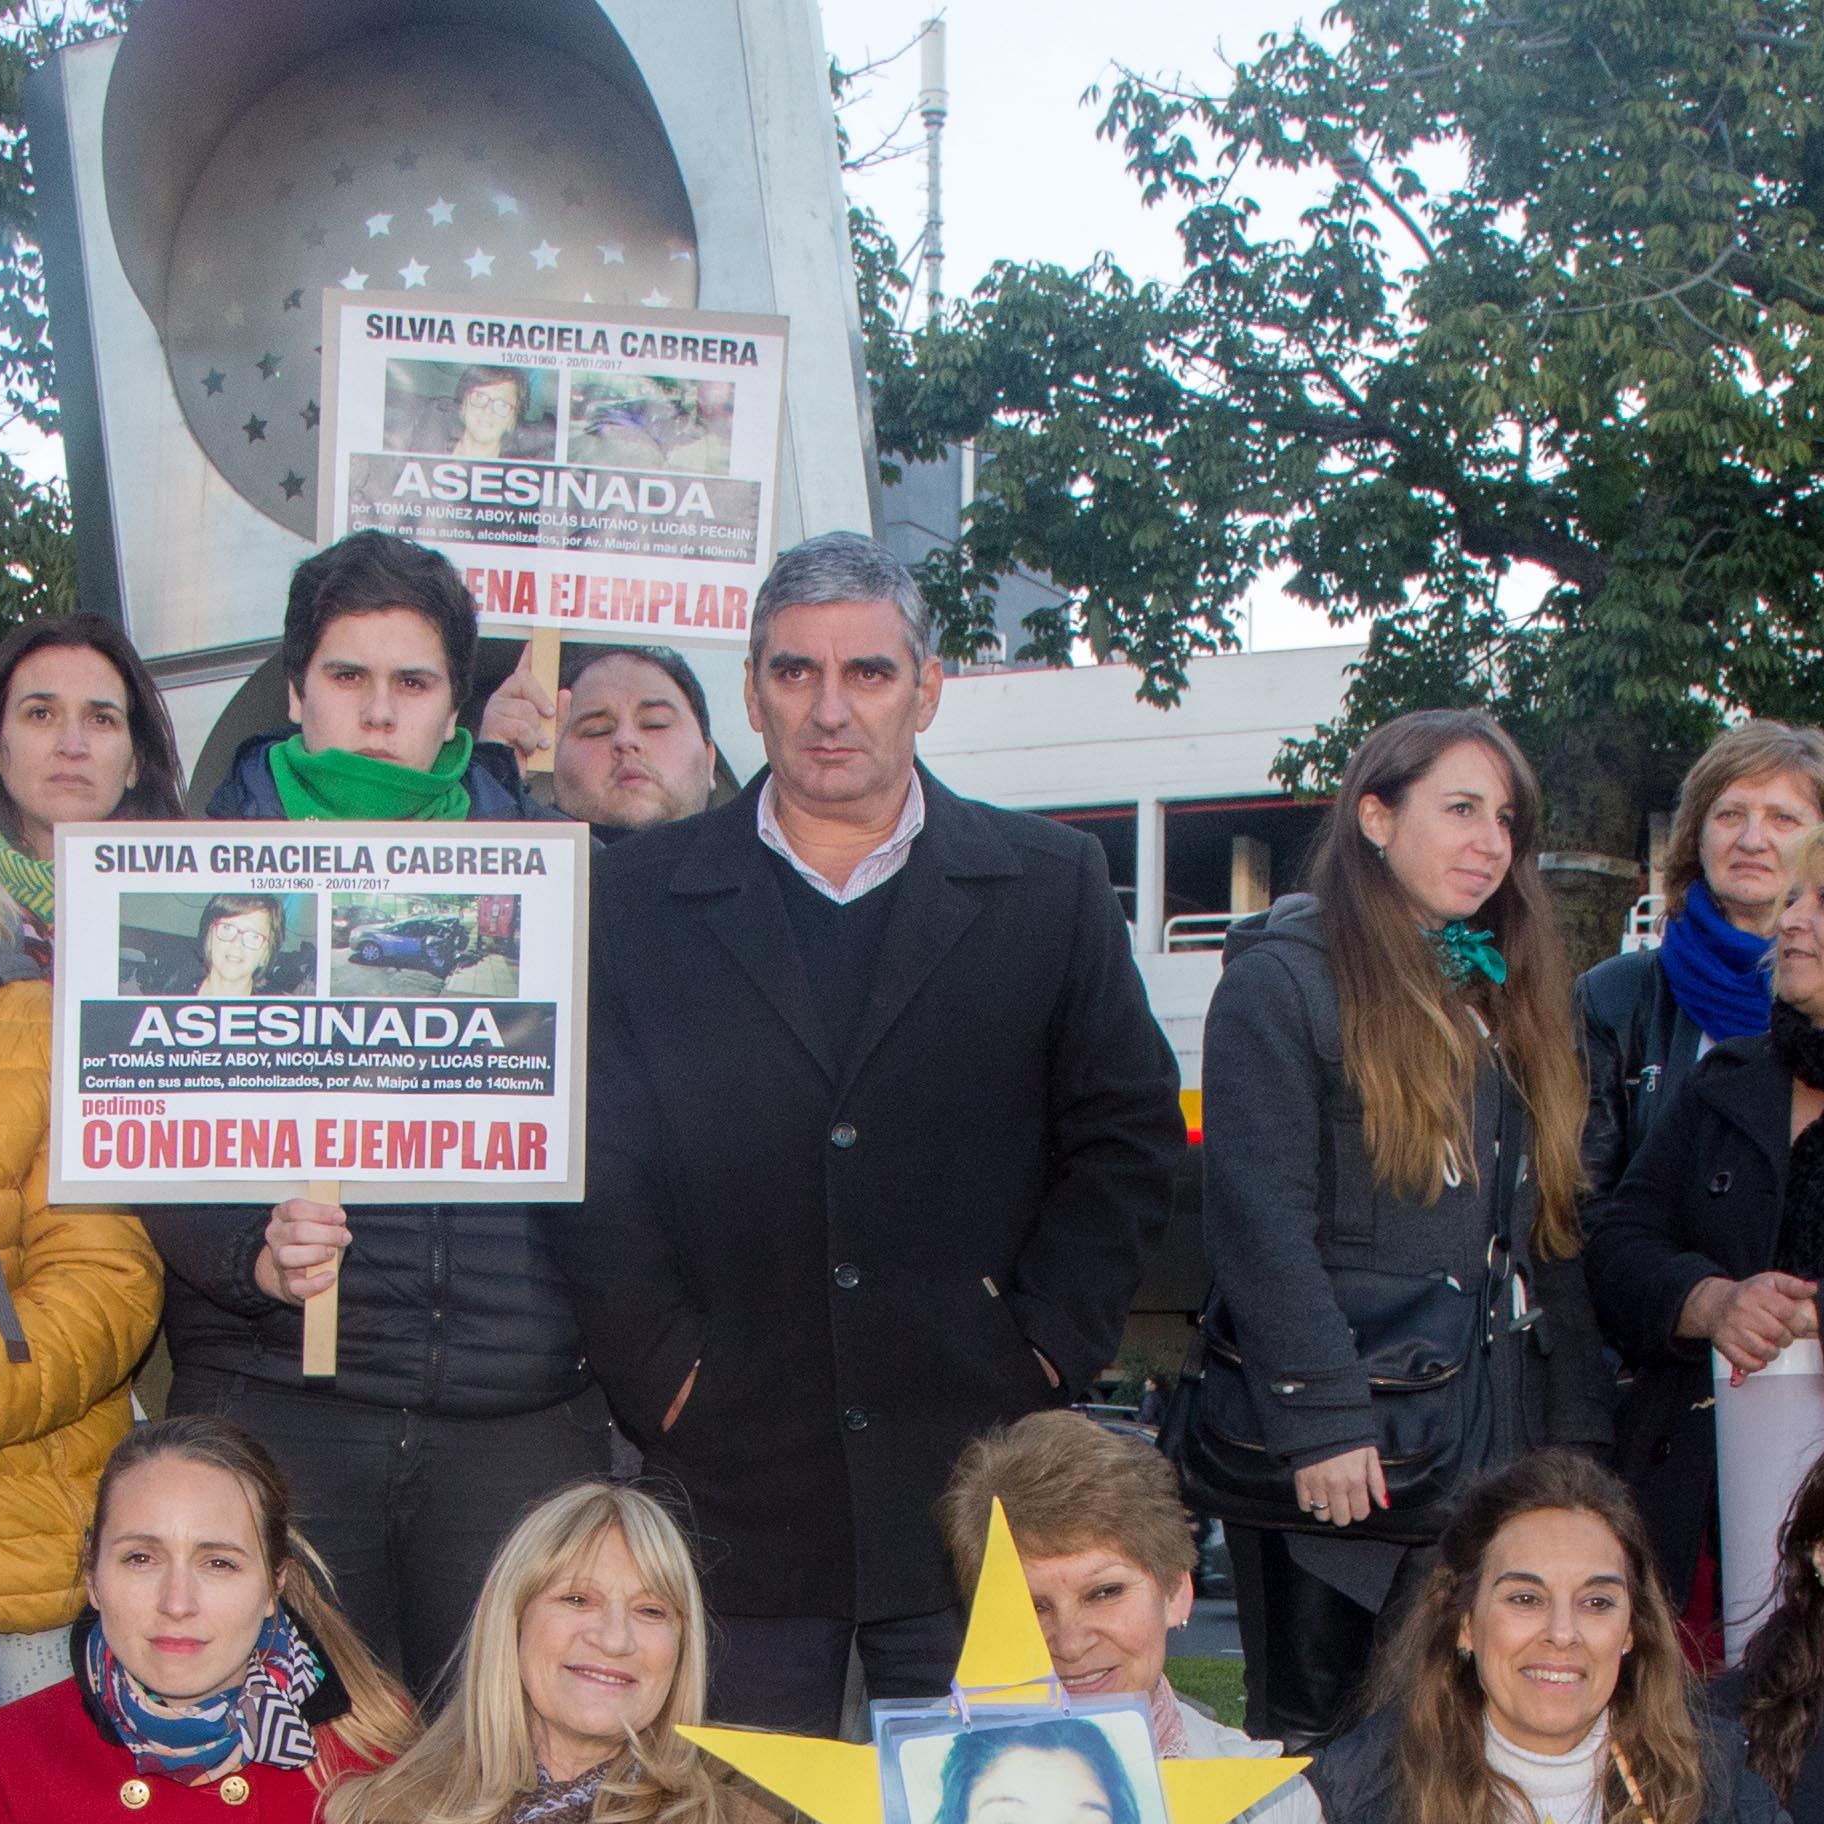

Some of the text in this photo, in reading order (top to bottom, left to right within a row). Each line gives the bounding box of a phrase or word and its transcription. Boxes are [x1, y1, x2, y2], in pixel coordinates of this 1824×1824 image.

[366, 313, 758, 367] SILVIA GRACIELA CABRERA
[500, 352, 622, 371] 13/03/1960 20/01/2017
[392, 462, 715, 520] ASESINADA
[351, 502, 754, 541] por TOMÁS NUÑEZ ABOY, NICOLÁS LAITANO y LUCAS PECHIN.
[399, 525, 413, 535] en
[416, 527, 436, 537] sus
[439, 528, 474, 540] autos,
[477, 529, 560, 546] alcoholizados,
[562, 537, 582, 548] por
[584, 536, 601, 548] Av.
[605, 538, 640, 551] Maipú
[643, 543, 650, 551] a
[653, 543, 677, 553] mas
[680, 543, 695, 555] de
[698, 545, 748, 559] 140km/h
[550, 572, 747, 631] EJEMPLAR
[94, 844, 547, 875] SILVIA GRACIELA CABRERA
[250, 878, 313, 890] 13/03/1960
[326, 878, 390, 891] 20/01/2017
[129, 1005, 505, 1049] ASESINADA
[83, 1050, 551, 1072] por TOMÁS NUÑEZ ABOY, NICOLÁS LAITANO y LUCAS PECHIN.
[85, 1073, 544, 1092] Corrían en sus autos, alcoholizados, por Av. Maipú a mas de 140km/h
[82, 1097, 165, 1117] pedimos
[82, 1119, 548, 1171] CONDENA EJEMPLAR
